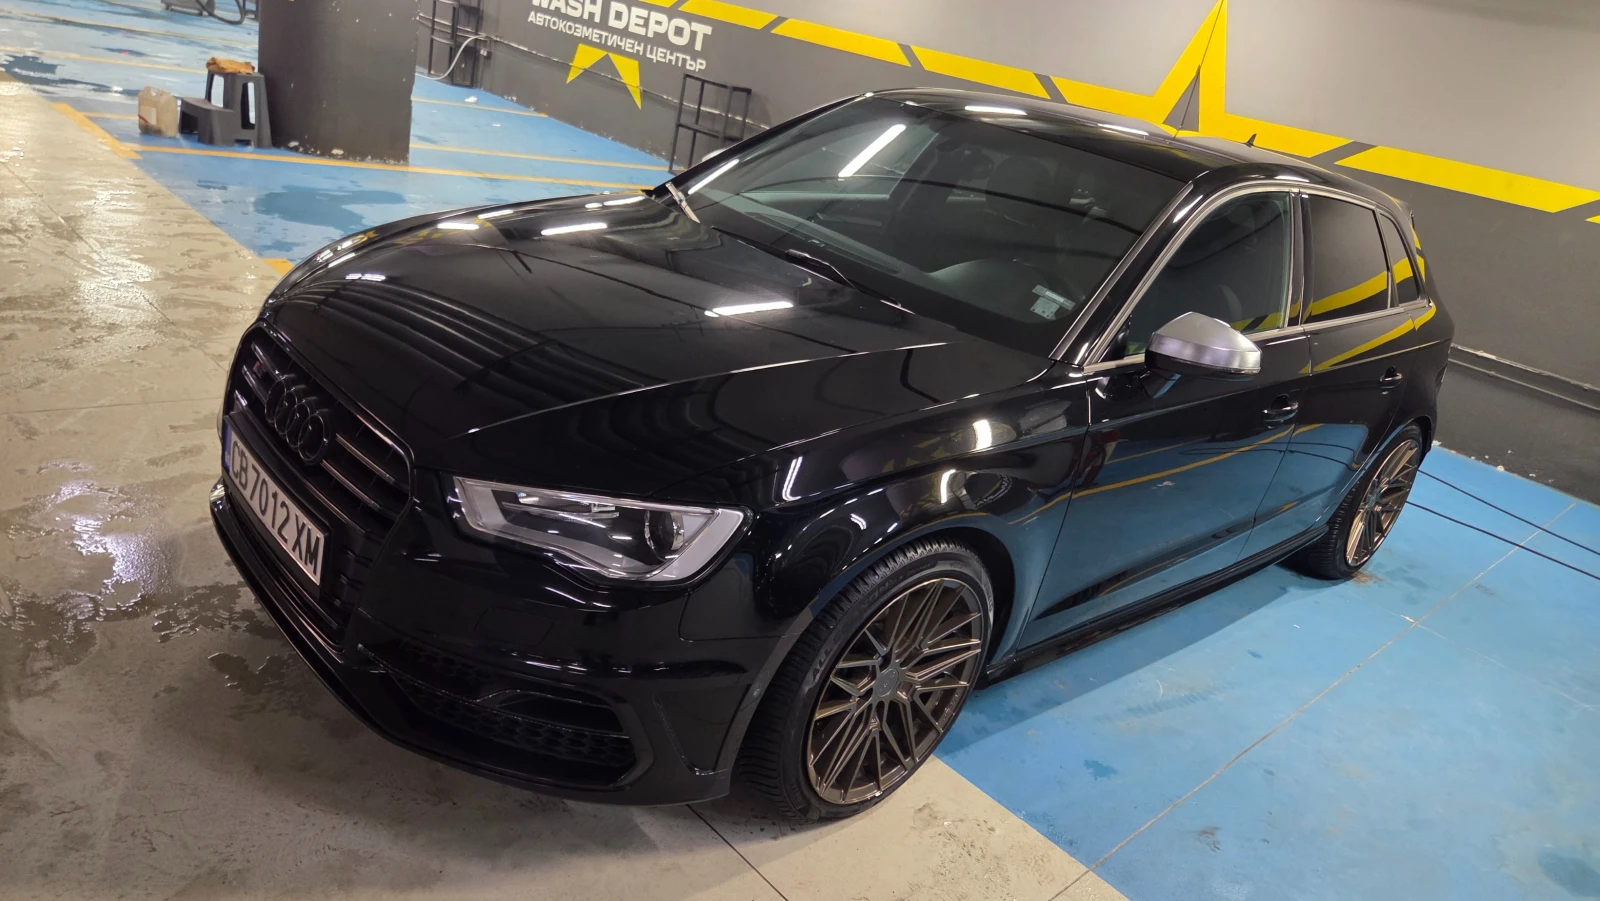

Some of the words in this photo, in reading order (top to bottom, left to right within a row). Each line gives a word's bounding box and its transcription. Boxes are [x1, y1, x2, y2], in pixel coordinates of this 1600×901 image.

[527, 11, 644, 55] АВТОКОЗМЕТИЧЕН
[646, 44, 707, 72] ЦЕНТЪР
[608, 1, 713, 51] DEPOT
